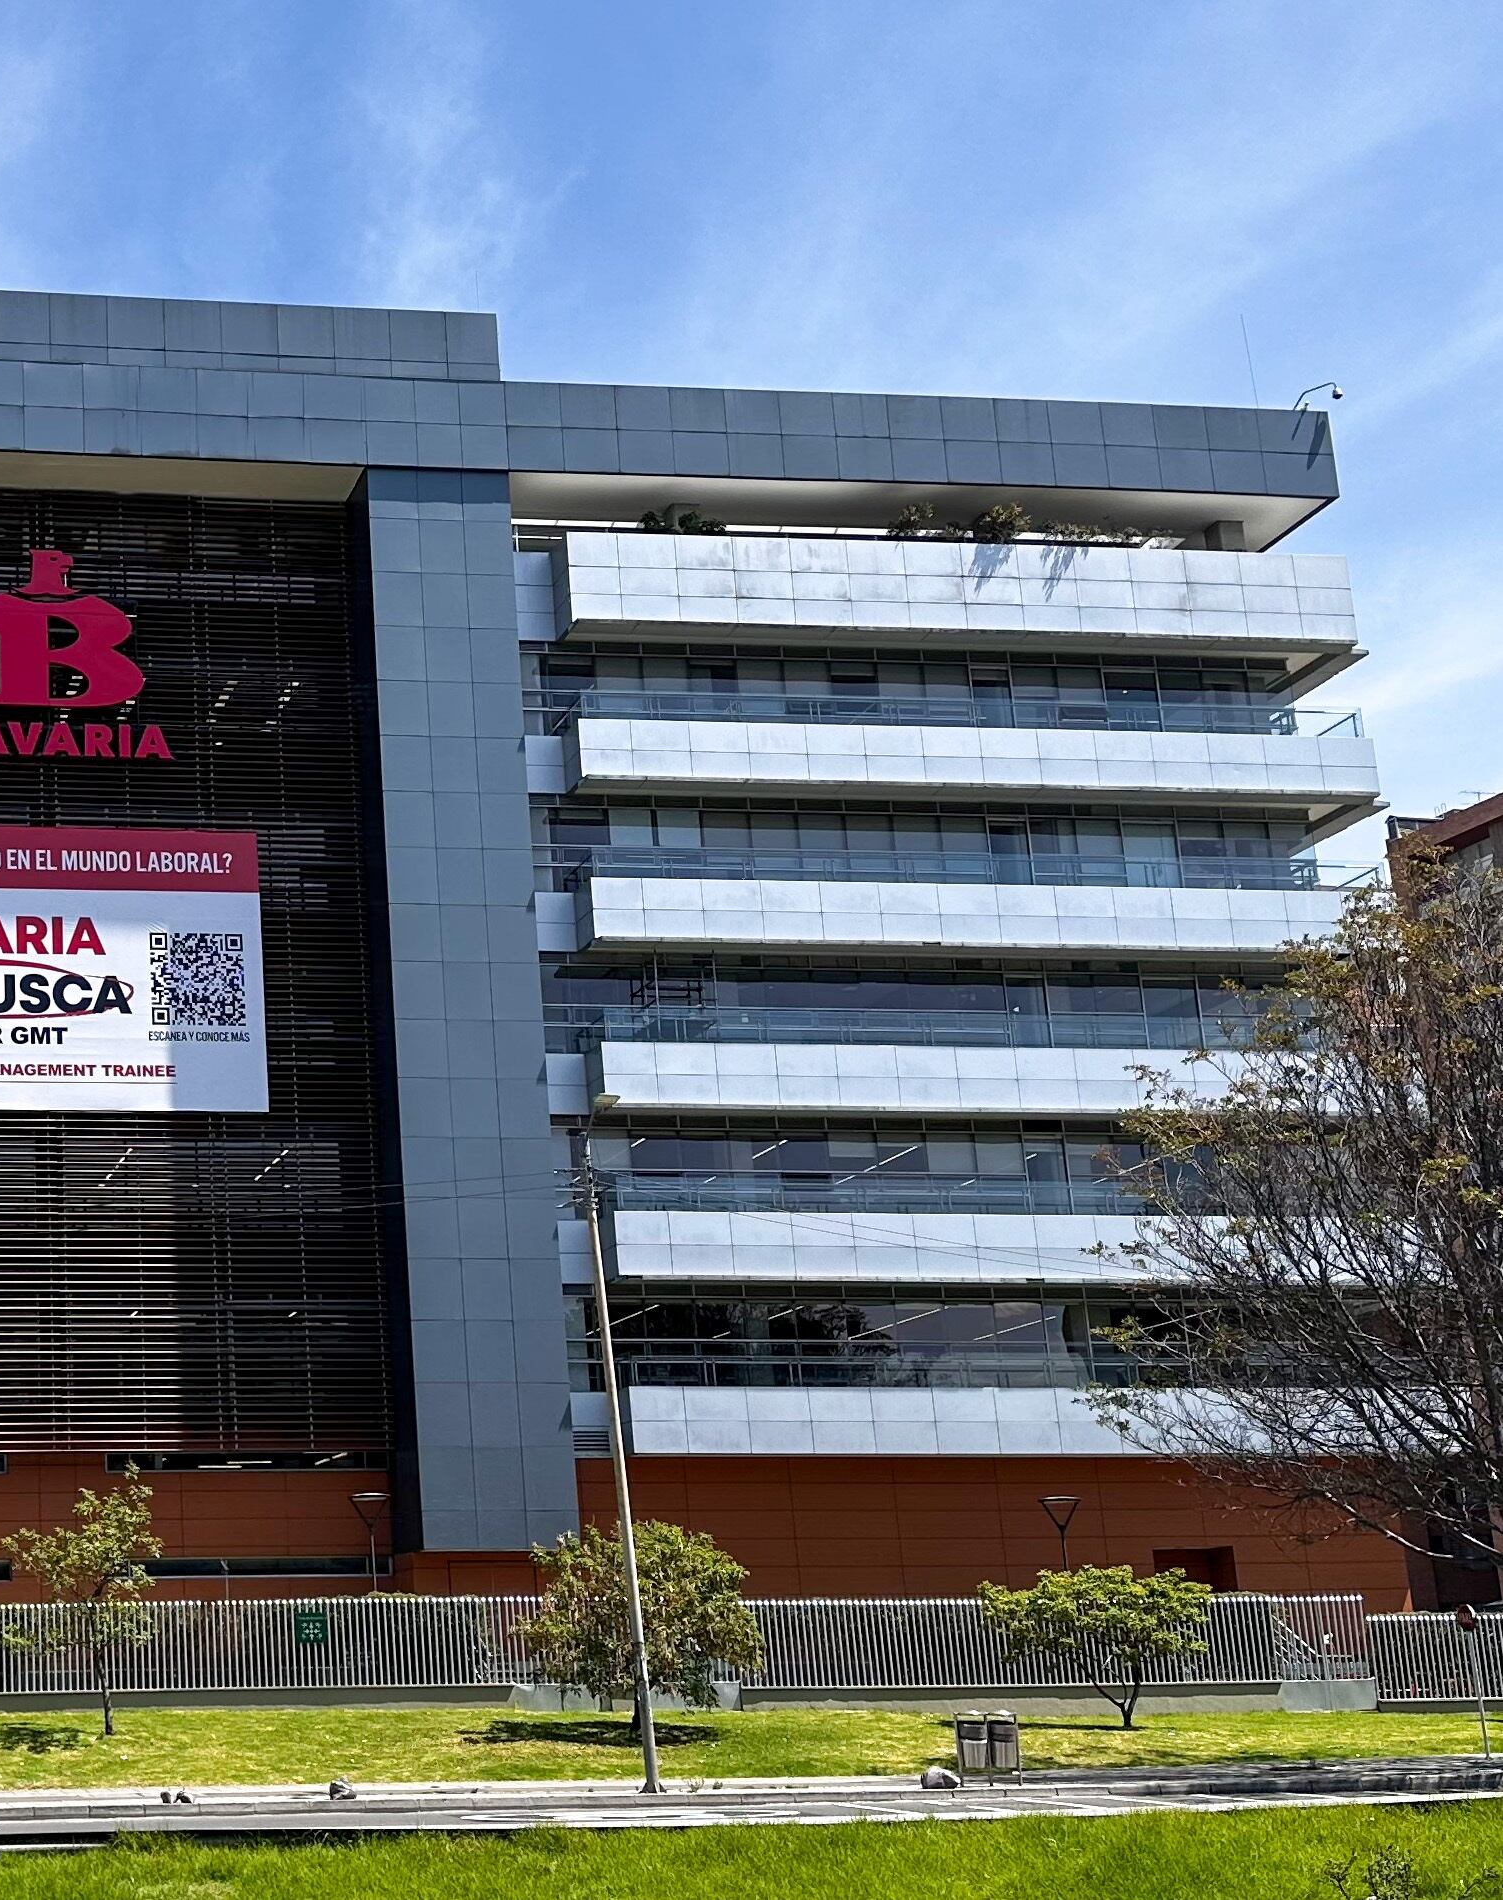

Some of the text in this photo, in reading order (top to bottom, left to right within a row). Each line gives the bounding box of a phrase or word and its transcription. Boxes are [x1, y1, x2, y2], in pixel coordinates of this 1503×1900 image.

[6, 849, 31, 870] EN
[35, 850, 58, 871] EL
[61, 850, 131, 872] MUNDO
[136, 851, 233, 874] LABORAL?
[10, 1027, 68, 1045] GMT
[148, 1030, 188, 1041] ESCANEA
[188, 1031, 195, 1041] Y
[195, 1031, 229, 1042] CONOCE
[101, 1064, 177, 1078] TRAINEE
